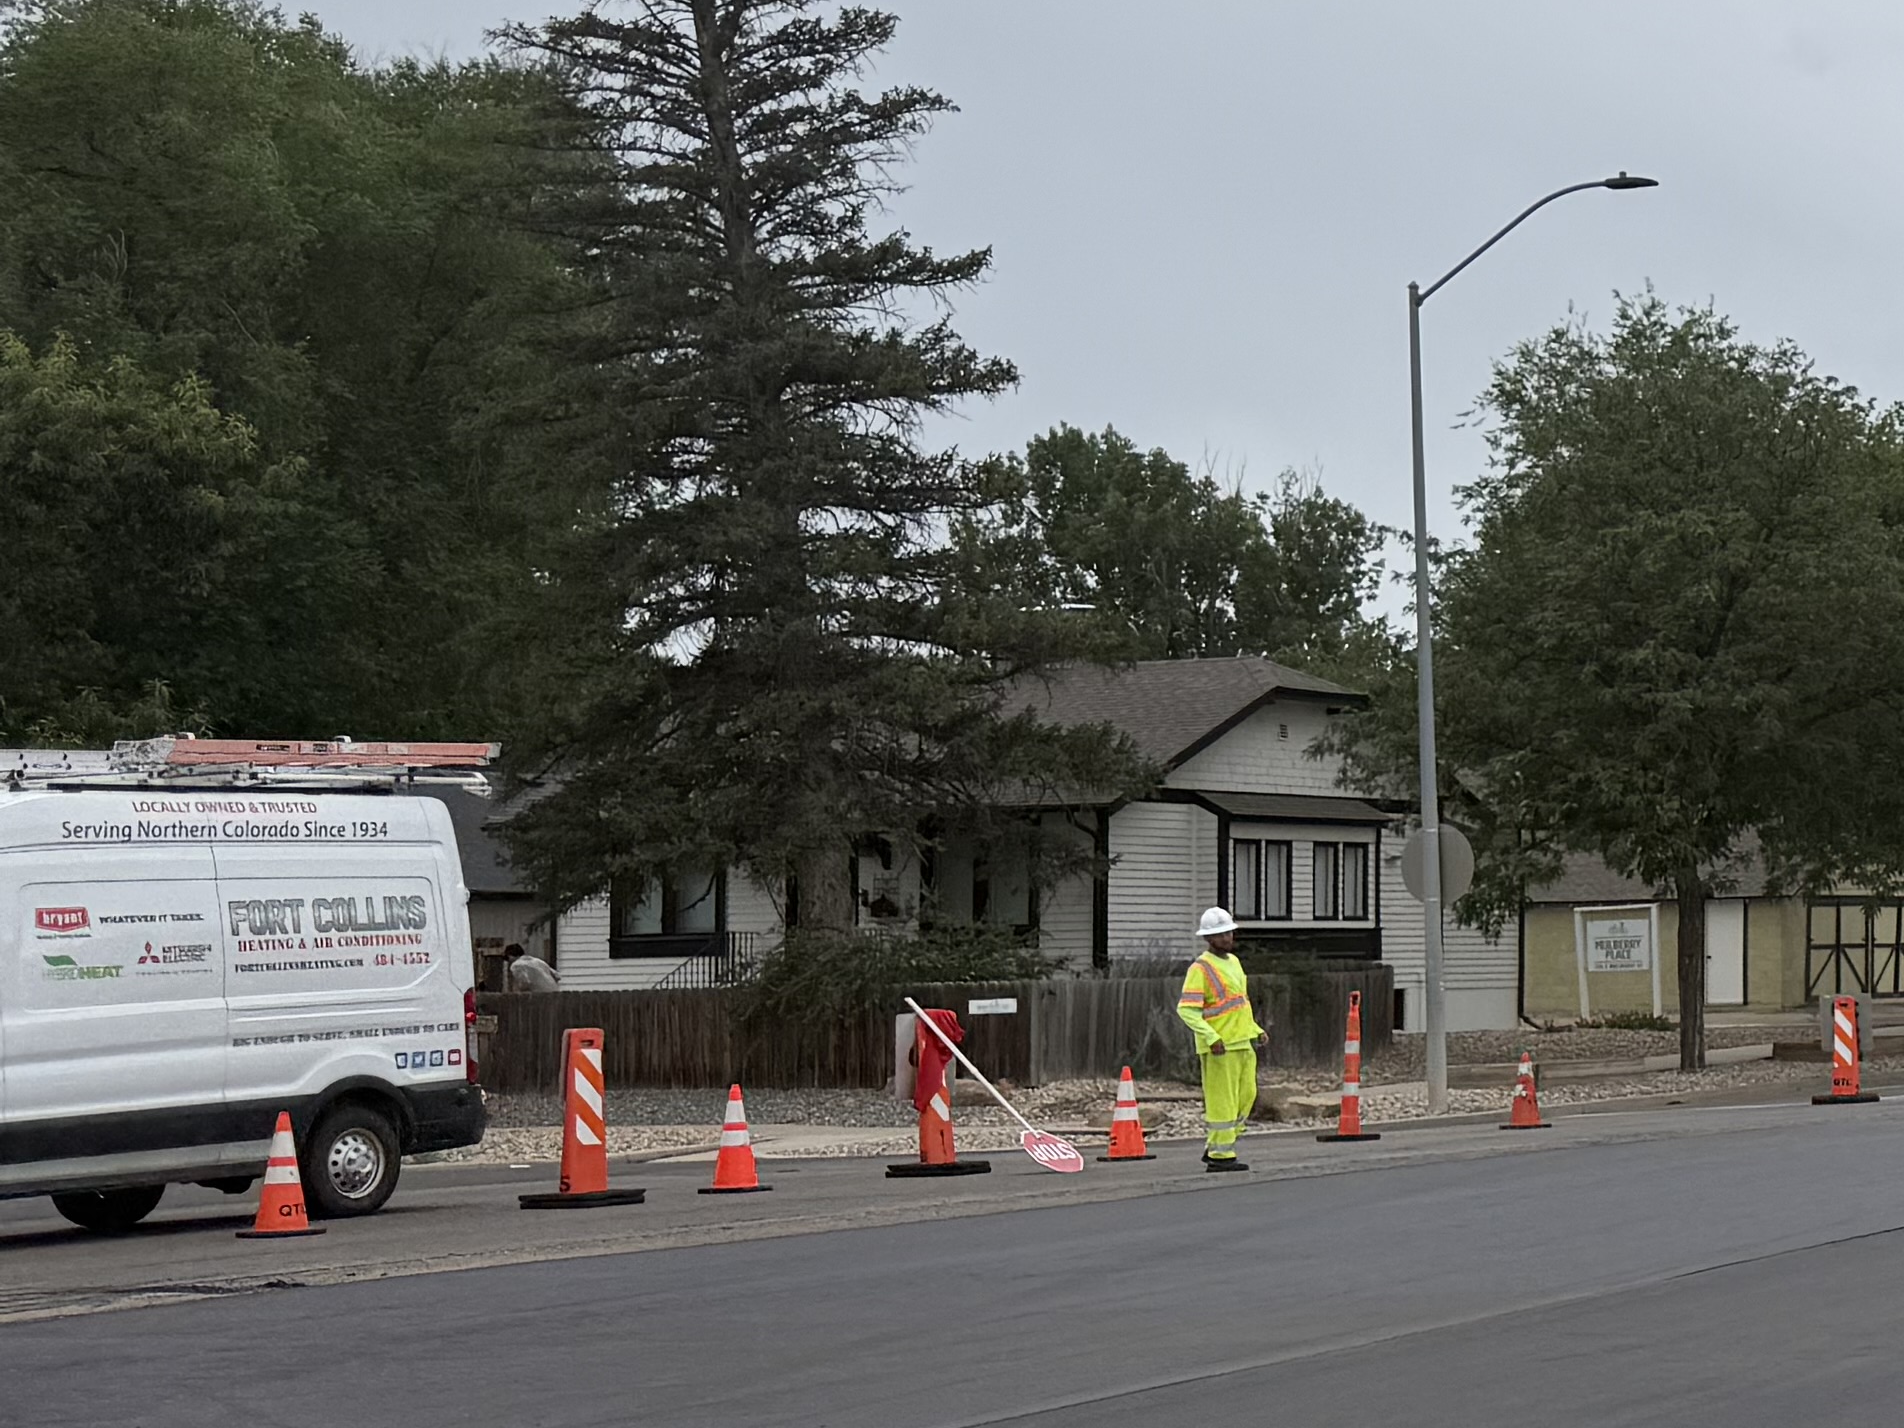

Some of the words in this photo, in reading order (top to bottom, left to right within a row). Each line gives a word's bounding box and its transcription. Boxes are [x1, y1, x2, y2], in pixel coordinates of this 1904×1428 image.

[132, 801, 191, 814] LOCALLY
[195, 801, 246, 814] OWNED
[249, 801, 259, 814] &
[262, 801, 317, 814] TRUSTED
[62, 821, 132, 841] Serving
[137, 821, 217, 839] Northern
[222, 820, 300, 838] Colorado
[304, 821, 346, 838] Since
[351, 821, 388, 838] 1934
[42, 912, 83, 926] bryant
[227, 898, 305, 937] FORT
[311, 895, 428, 933] COLLINS
[238, 938, 294, 952] HEATING
[298, 938, 307, 950] &
[312, 937, 333, 950] AIR
[337, 933, 422, 948] CONDITIONING
[1032, 1142, 1077, 1162] STOP
